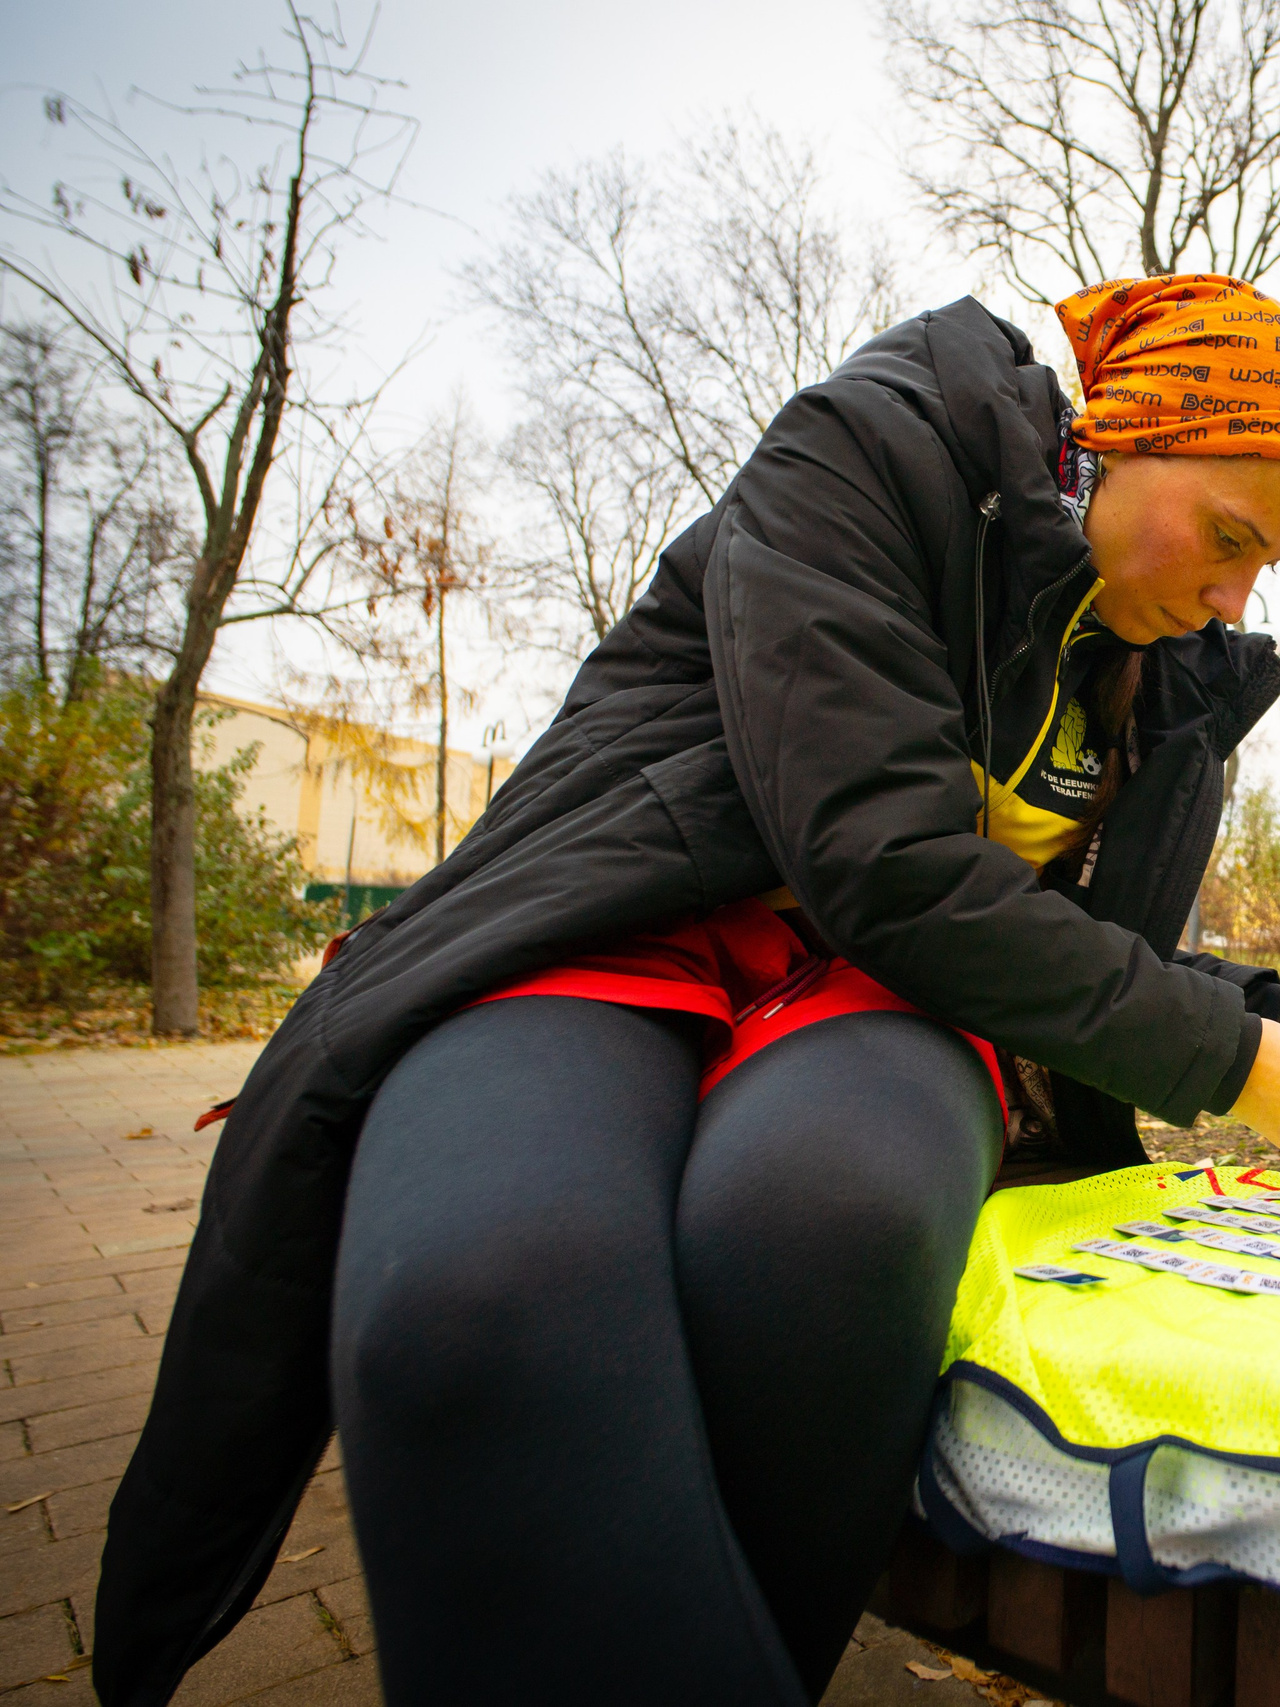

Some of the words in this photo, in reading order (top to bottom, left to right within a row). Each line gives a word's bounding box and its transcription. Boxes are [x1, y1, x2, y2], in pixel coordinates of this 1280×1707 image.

[1144, 362, 1211, 382] Вёрст
[1181, 393, 1260, 416] Вёрст
[1134, 427, 1208, 452] Вёрст
[1048, 774, 1059, 784] DE
[1060, 778, 1098, 790] LEEUWK
[1050, 784, 1096, 799] TERALFEN
